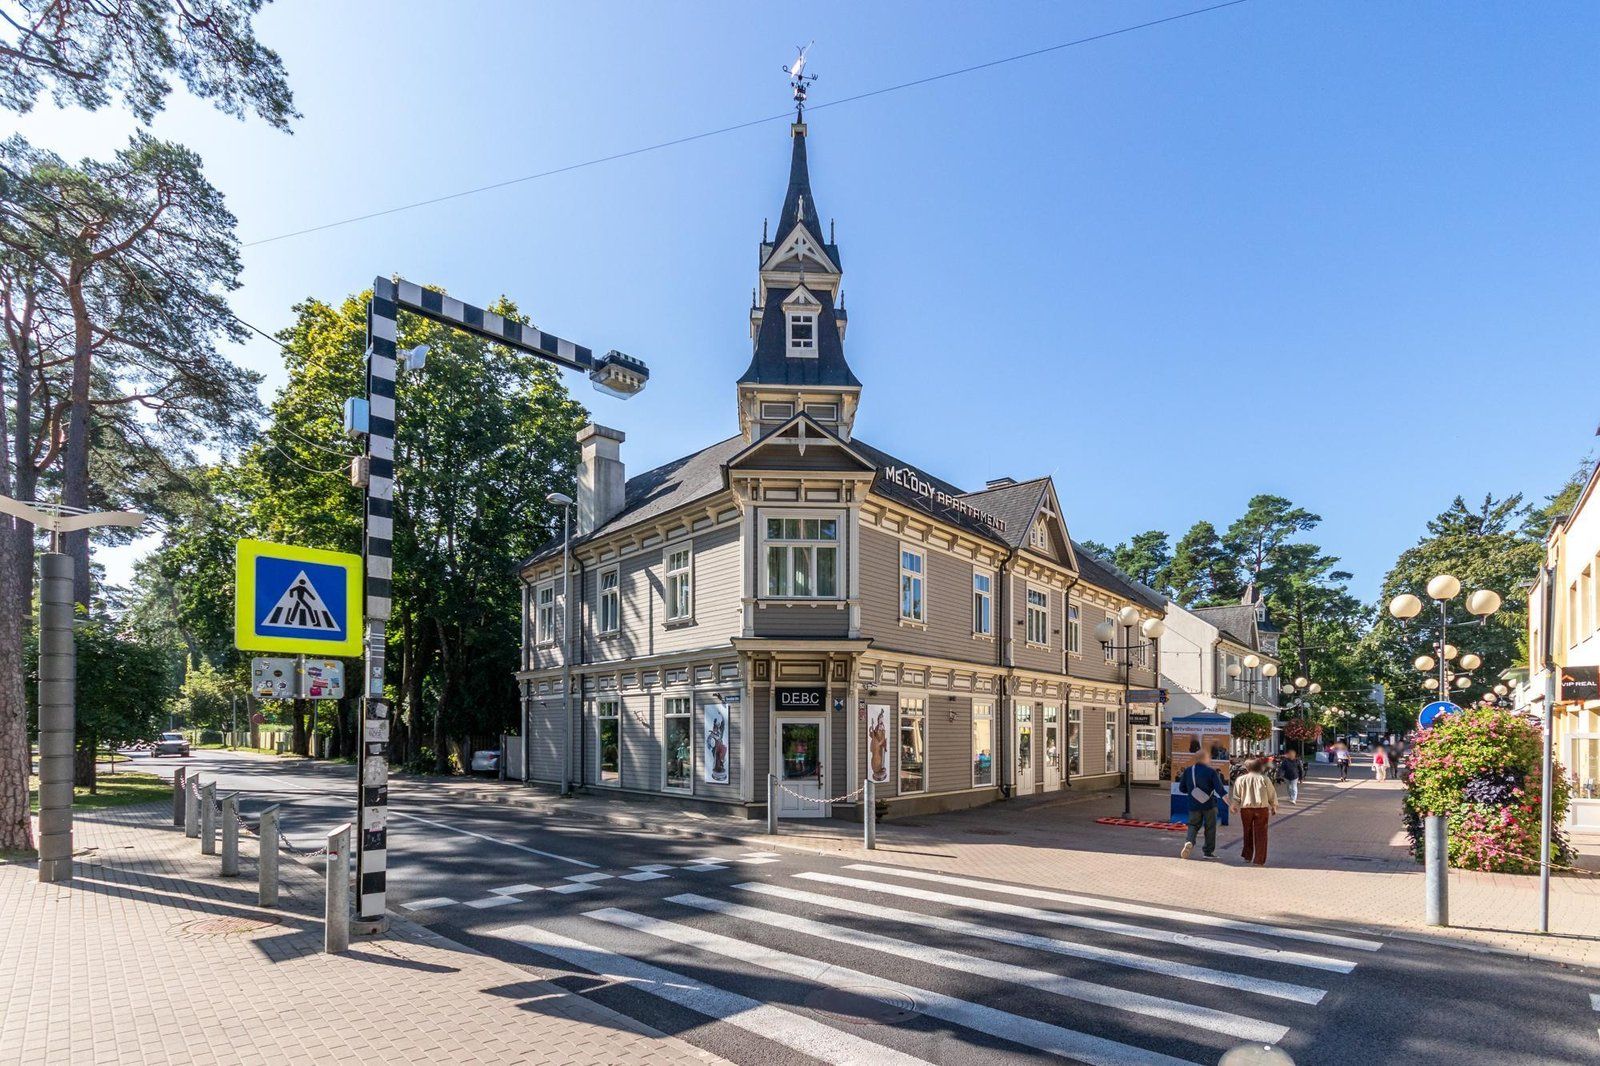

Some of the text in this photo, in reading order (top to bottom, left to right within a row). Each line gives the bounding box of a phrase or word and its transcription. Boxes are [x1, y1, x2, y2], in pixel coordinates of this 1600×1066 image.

[885, 465, 1008, 532] MELODY APARTAMENTI
[781, 692, 819, 704] D.E.B.C
